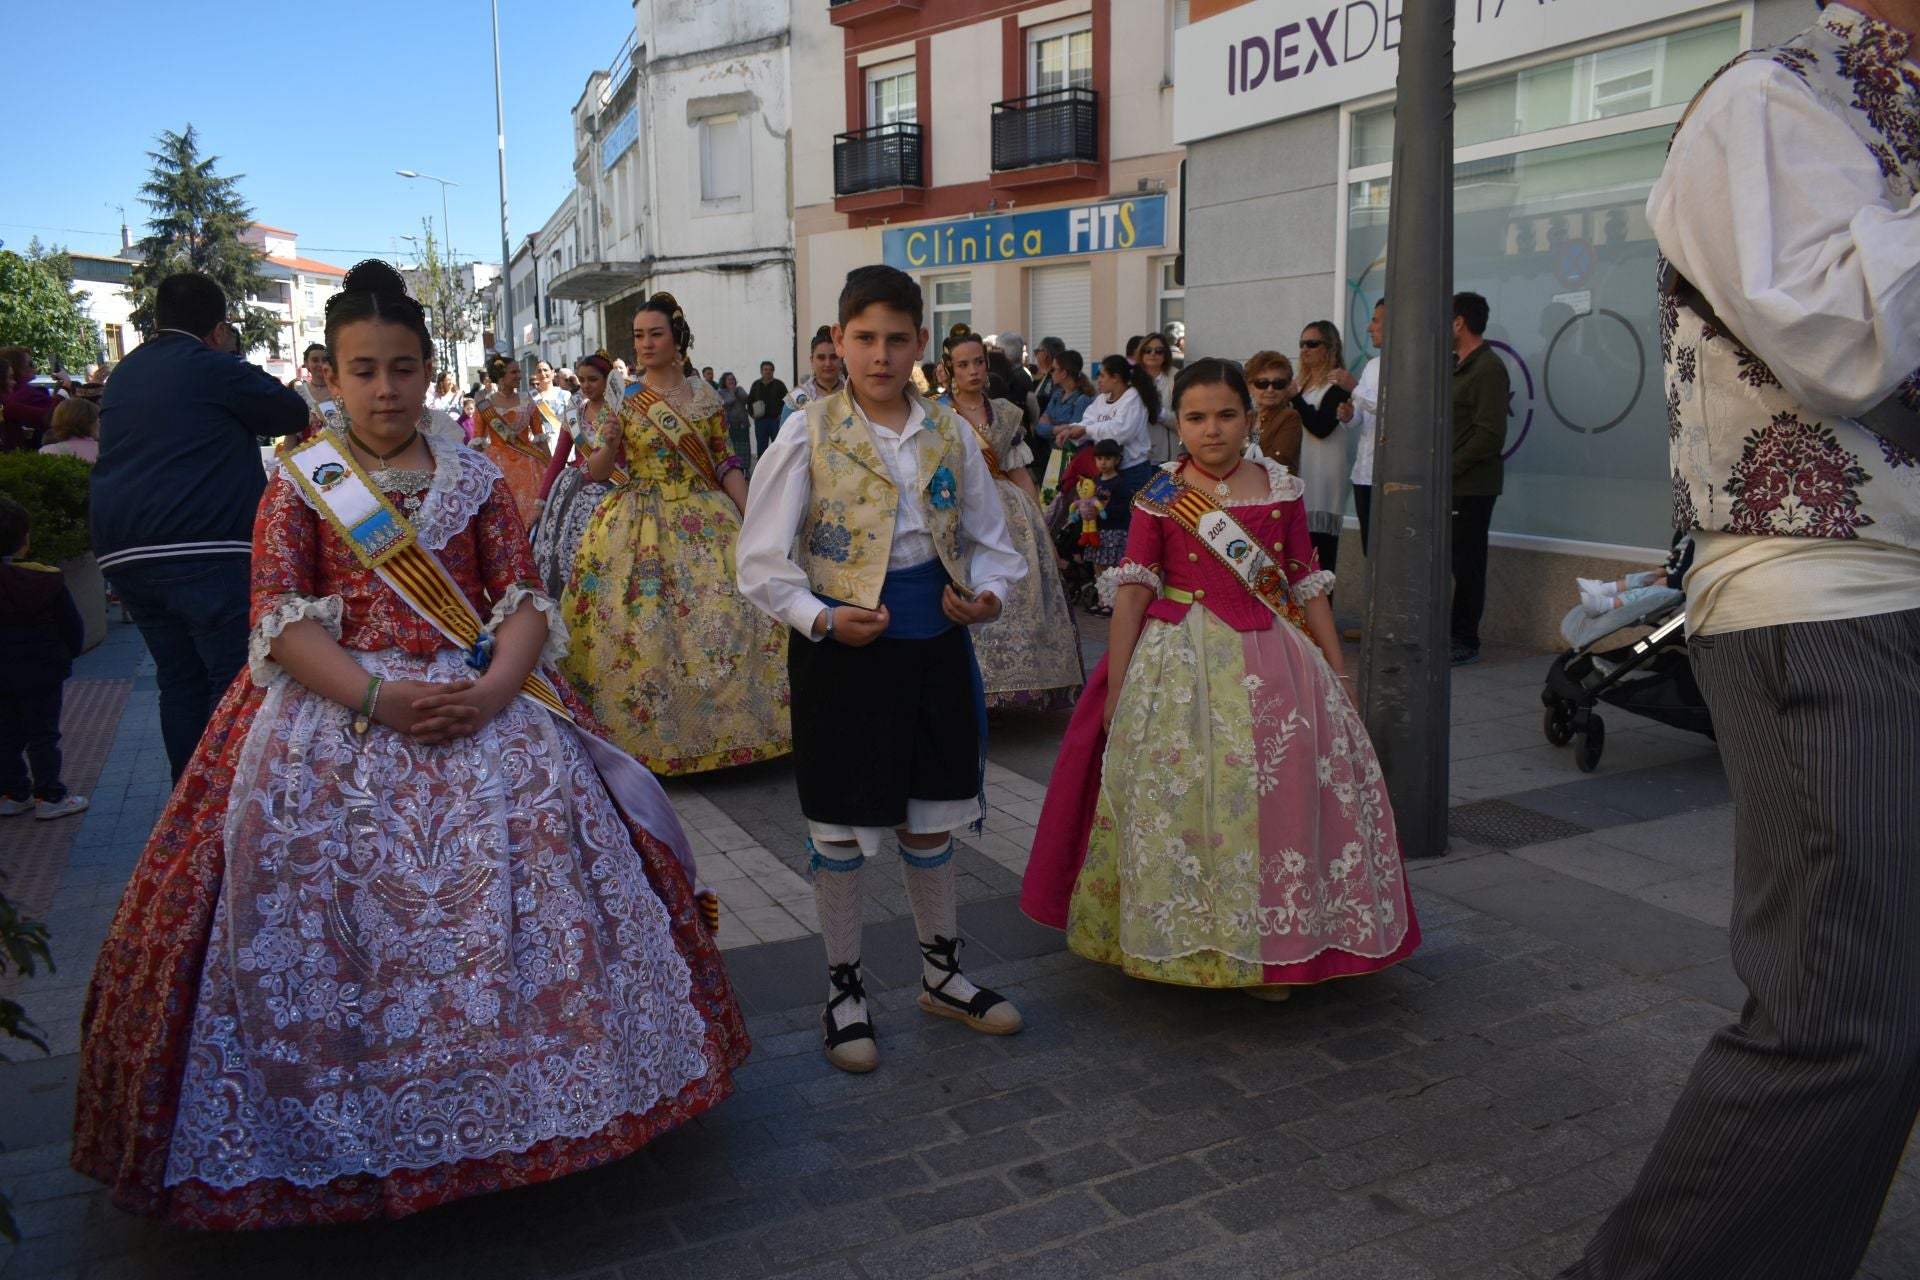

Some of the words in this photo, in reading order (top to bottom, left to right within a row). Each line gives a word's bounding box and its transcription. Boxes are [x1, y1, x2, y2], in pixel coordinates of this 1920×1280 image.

[906, 224, 1042, 266] Clínica
[1069, 202, 1135, 252] FITS
[1207, 518, 1227, 541] 2025
